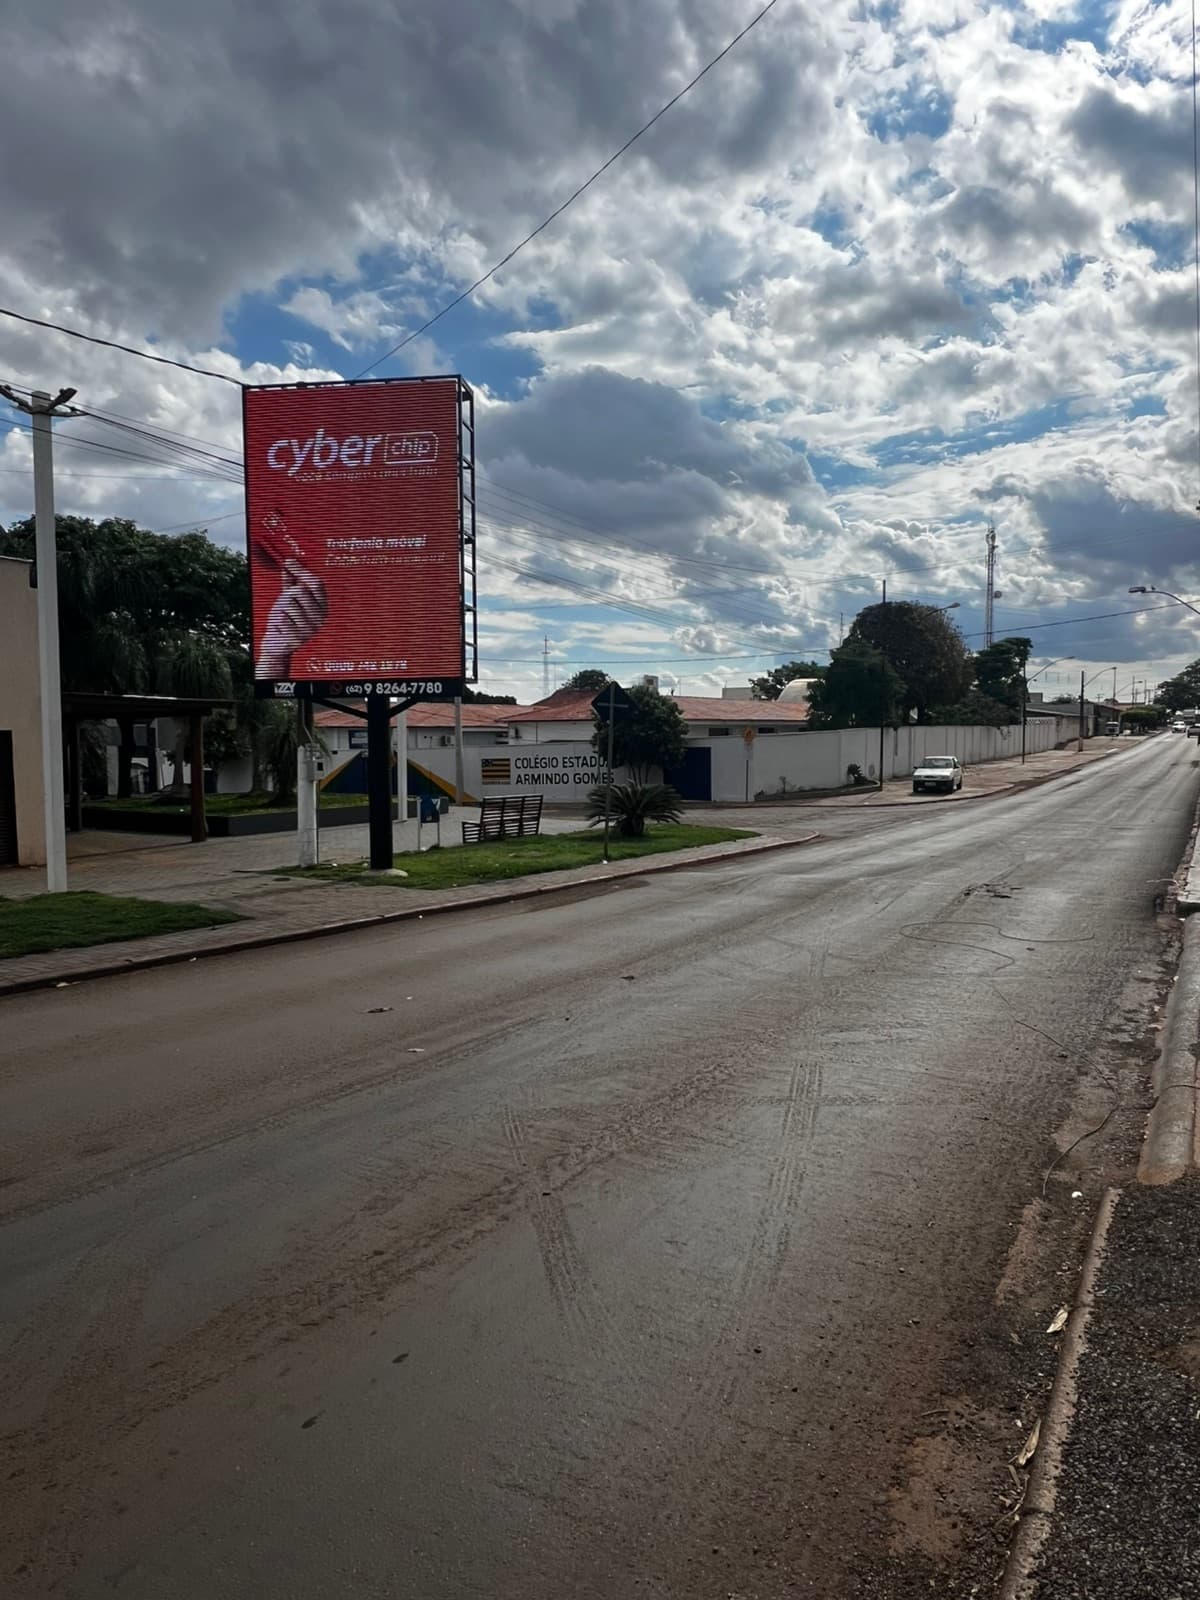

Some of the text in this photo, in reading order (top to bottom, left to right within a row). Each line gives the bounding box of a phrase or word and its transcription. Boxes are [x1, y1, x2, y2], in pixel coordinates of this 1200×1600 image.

[267, 428, 383, 476] cyber
[391, 438, 430, 456] chip
[363, 683, 373, 694] 9
[375, 682, 442, 694] 8264-7780
[514, 754, 559, 769] COLÉGIO
[515, 772, 615, 785] ARMINDO GOMES
